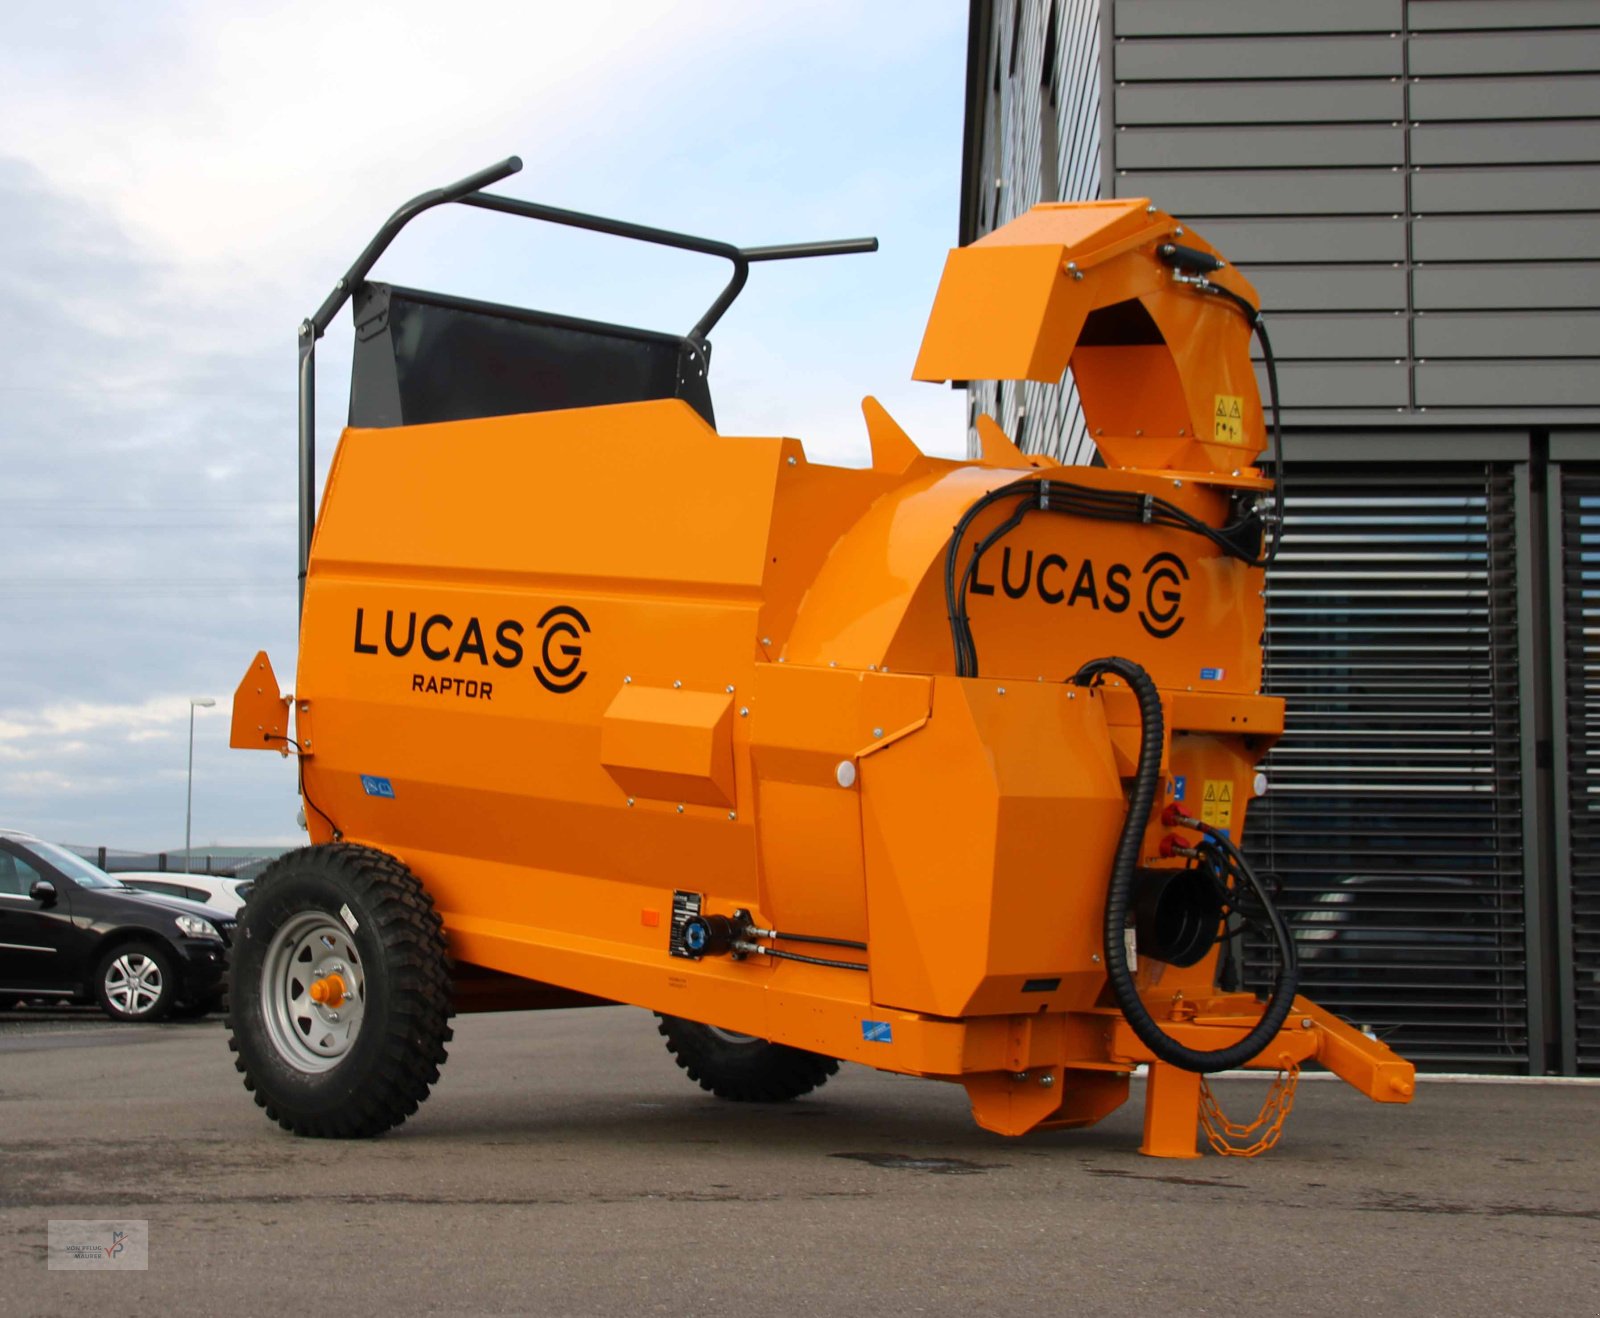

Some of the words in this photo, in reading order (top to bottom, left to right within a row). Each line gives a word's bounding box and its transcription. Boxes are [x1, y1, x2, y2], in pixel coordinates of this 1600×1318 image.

[969, 542, 1132, 614] LUCAS
[353, 607, 524, 669] LUCAS
[411, 673, 493, 701] RAPTOR
